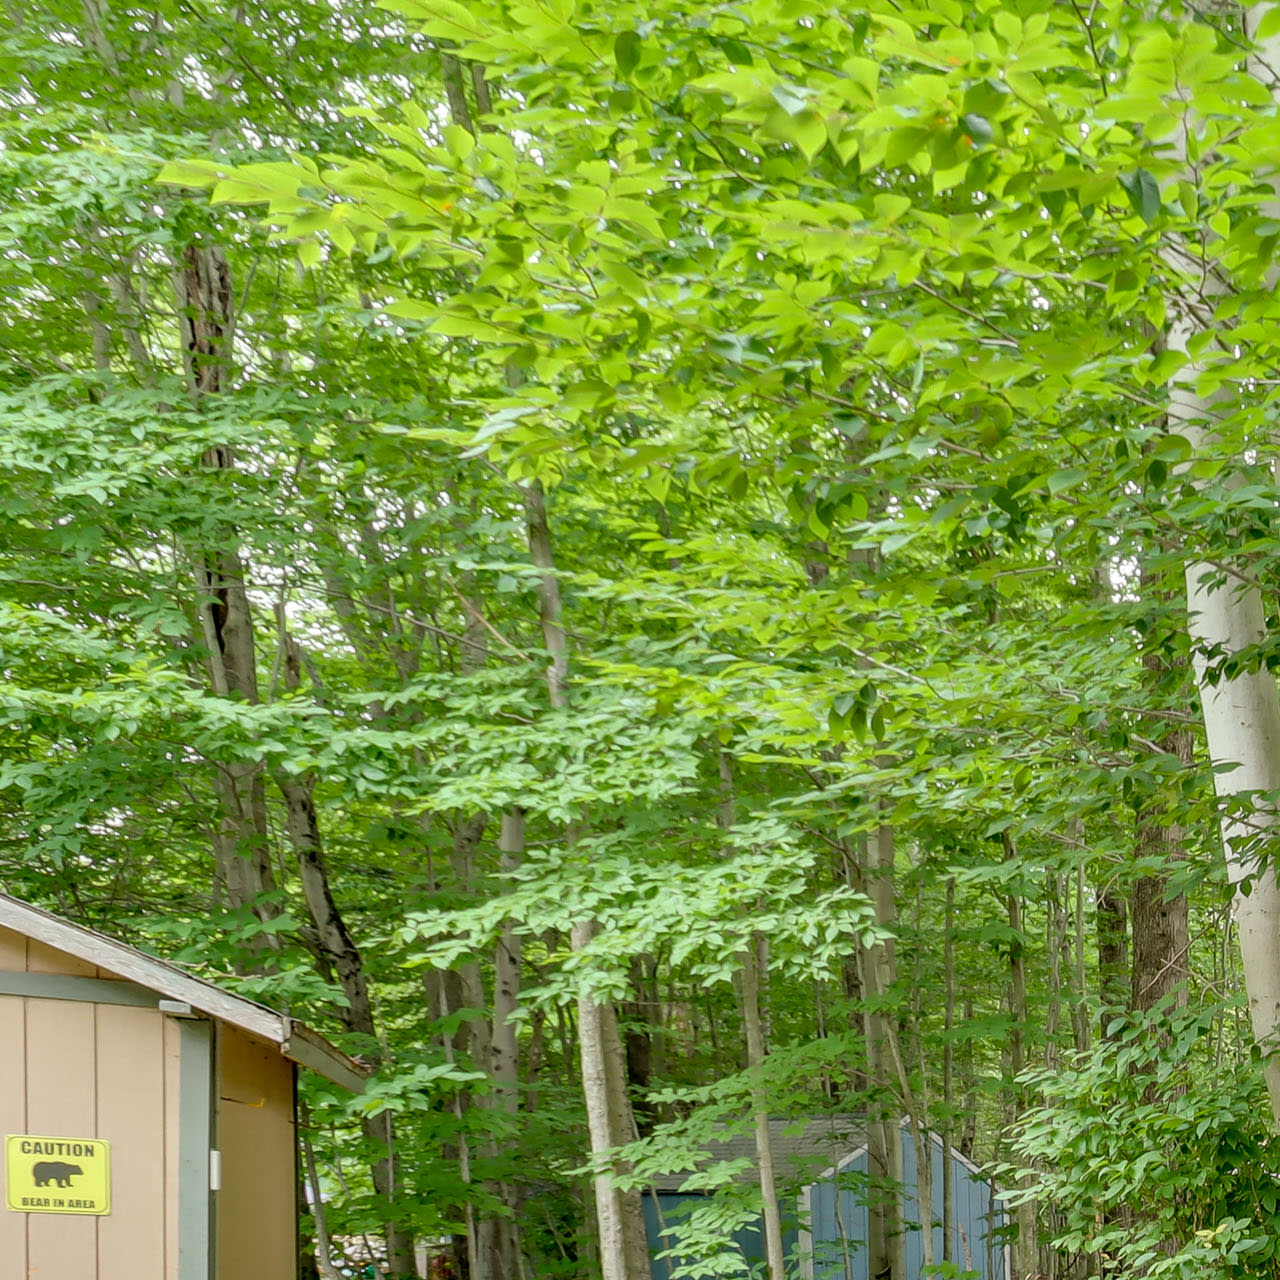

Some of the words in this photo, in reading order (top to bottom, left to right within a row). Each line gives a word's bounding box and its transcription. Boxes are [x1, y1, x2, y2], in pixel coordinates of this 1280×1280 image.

[21, 1141, 94, 1157] CAUTION
[22, 1197, 50, 1207] BEAR
[53, 1198, 65, 1208] IN
[68, 1199, 95, 1209] AREA
